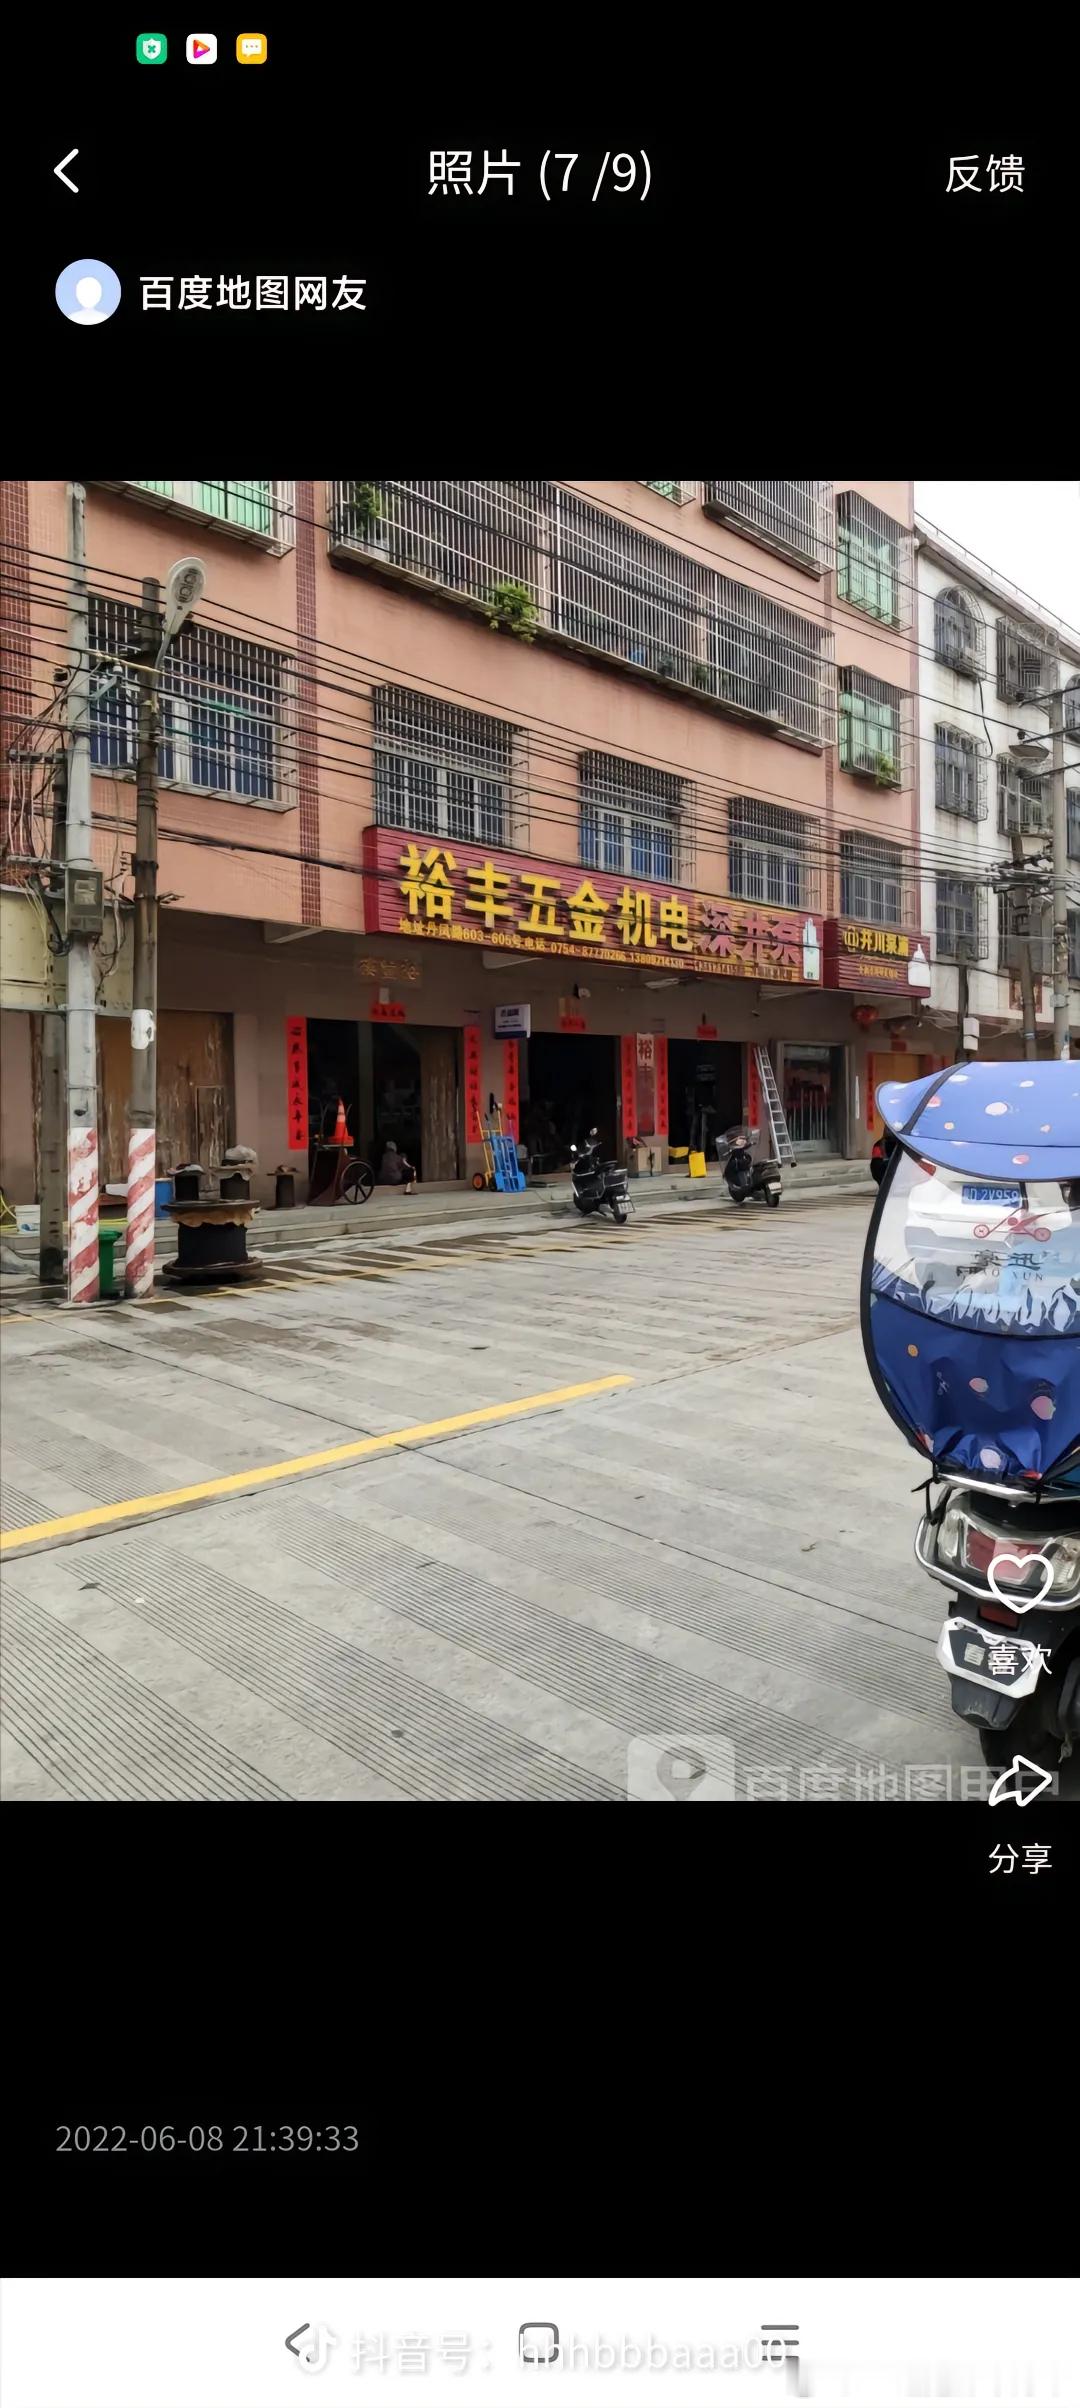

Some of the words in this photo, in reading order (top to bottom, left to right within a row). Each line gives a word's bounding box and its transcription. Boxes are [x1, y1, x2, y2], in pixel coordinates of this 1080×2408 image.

[399, 843, 694, 952] 裕丰五金机电
